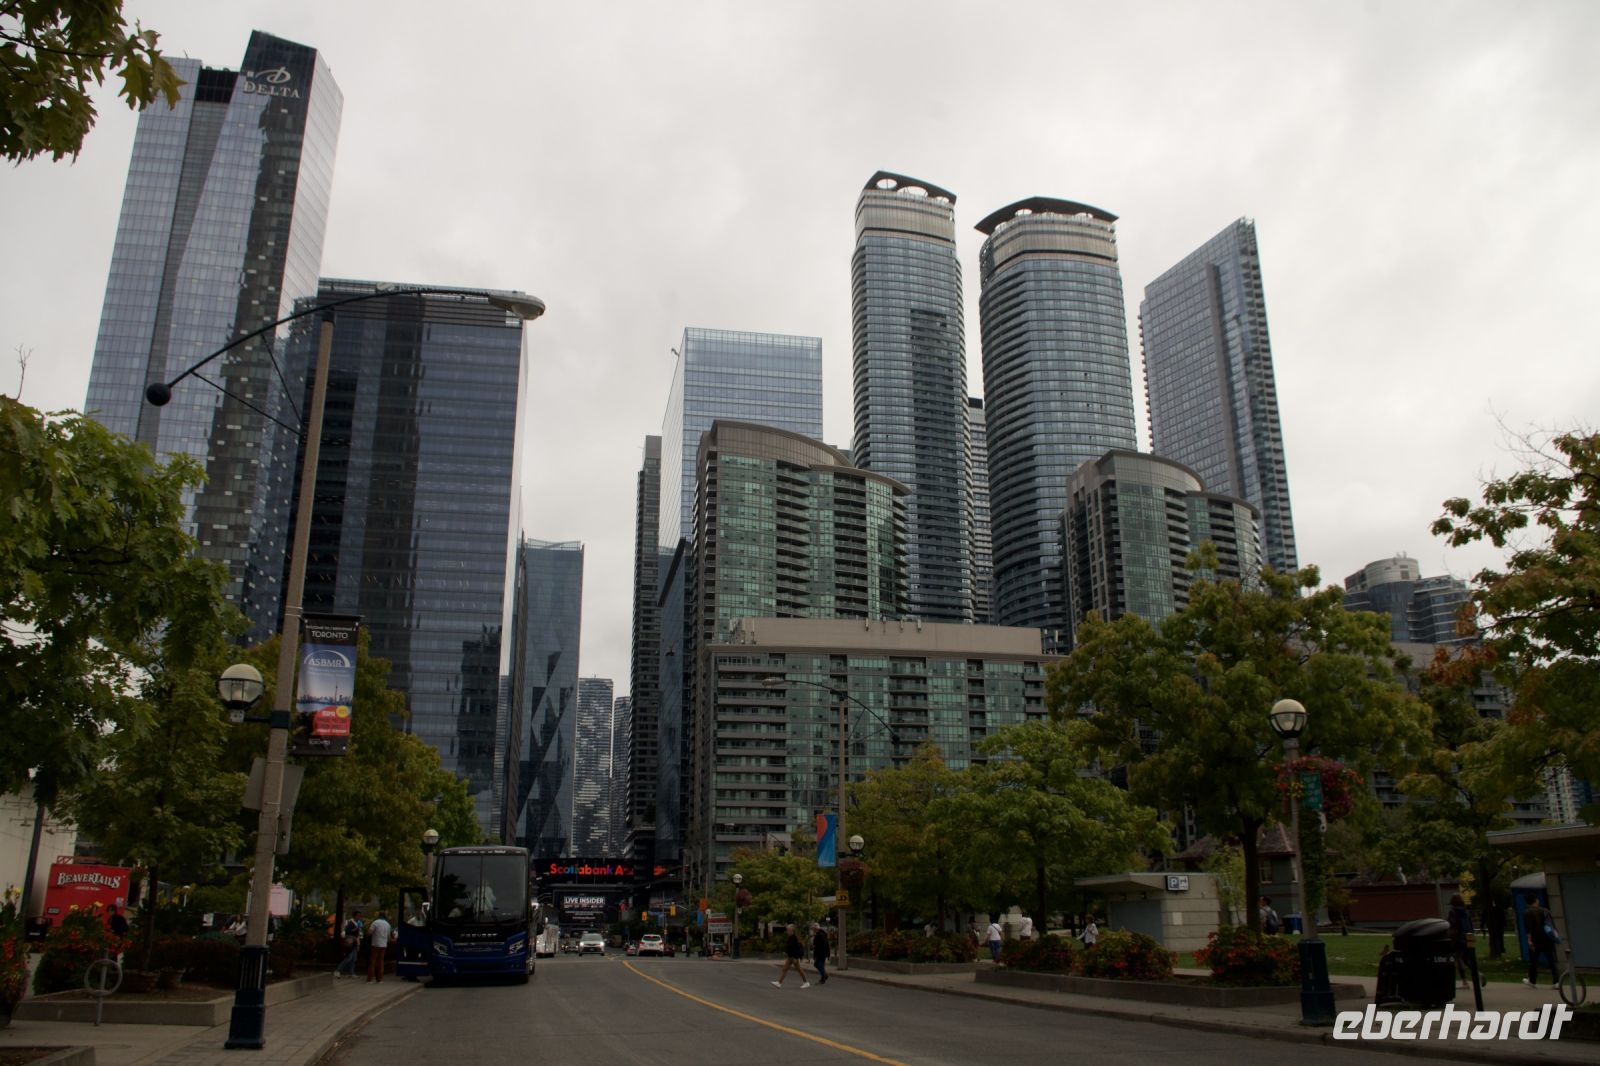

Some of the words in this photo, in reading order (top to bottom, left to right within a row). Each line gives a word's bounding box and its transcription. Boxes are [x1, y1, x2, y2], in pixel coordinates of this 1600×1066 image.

[243, 81, 300, 98] DELTA
[311, 630, 348, 640] TORONTO
[549, 863, 613, 876] Scotiabank
